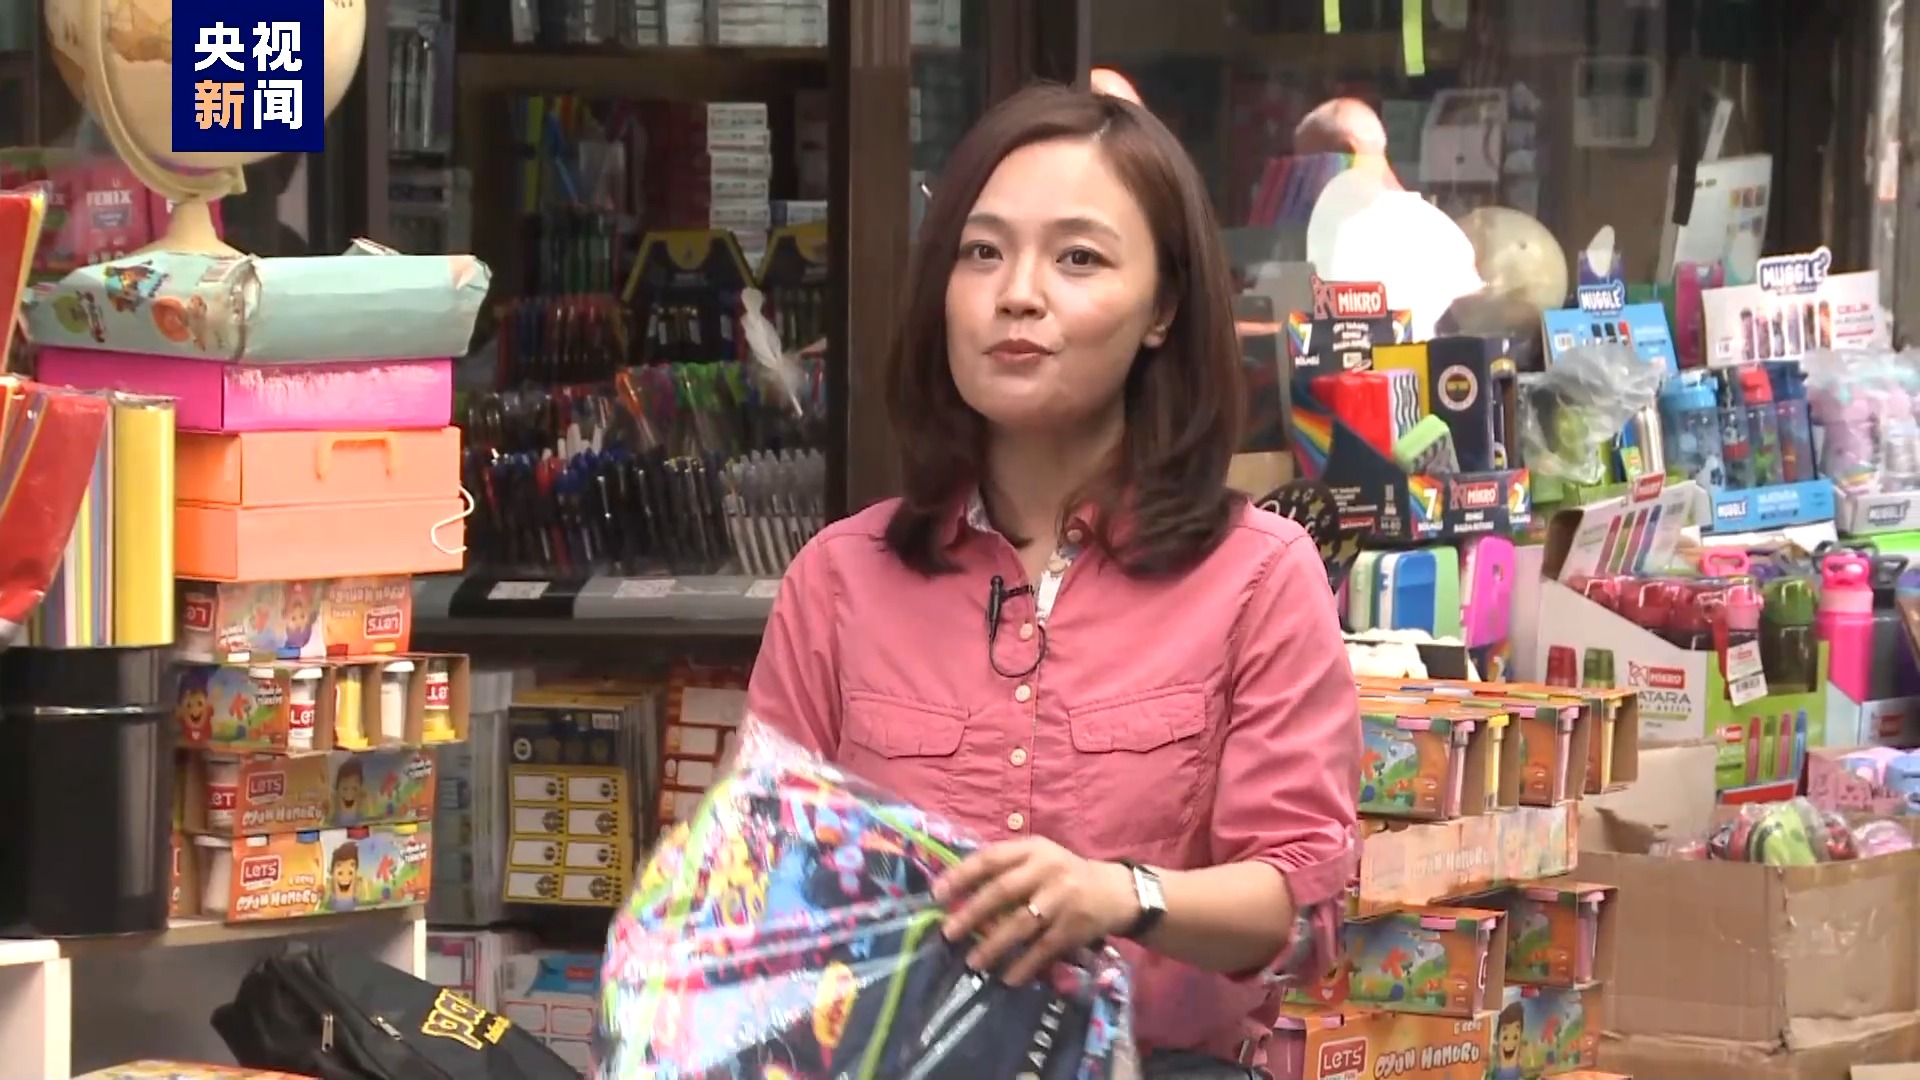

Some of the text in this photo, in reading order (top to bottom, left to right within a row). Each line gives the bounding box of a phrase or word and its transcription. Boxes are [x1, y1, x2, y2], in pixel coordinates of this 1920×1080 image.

[1762, 260, 1823, 287] MUGGLE
[1580, 287, 1622, 310] MUGGLE
[1298, 322, 1313, 355] 7
[1423, 488, 1438, 520] 7
[1513, 483, 1526, 513] 2
[1638, 690, 1691, 705] ATARA
[1028, 998, 1066, 1070] ADEL
